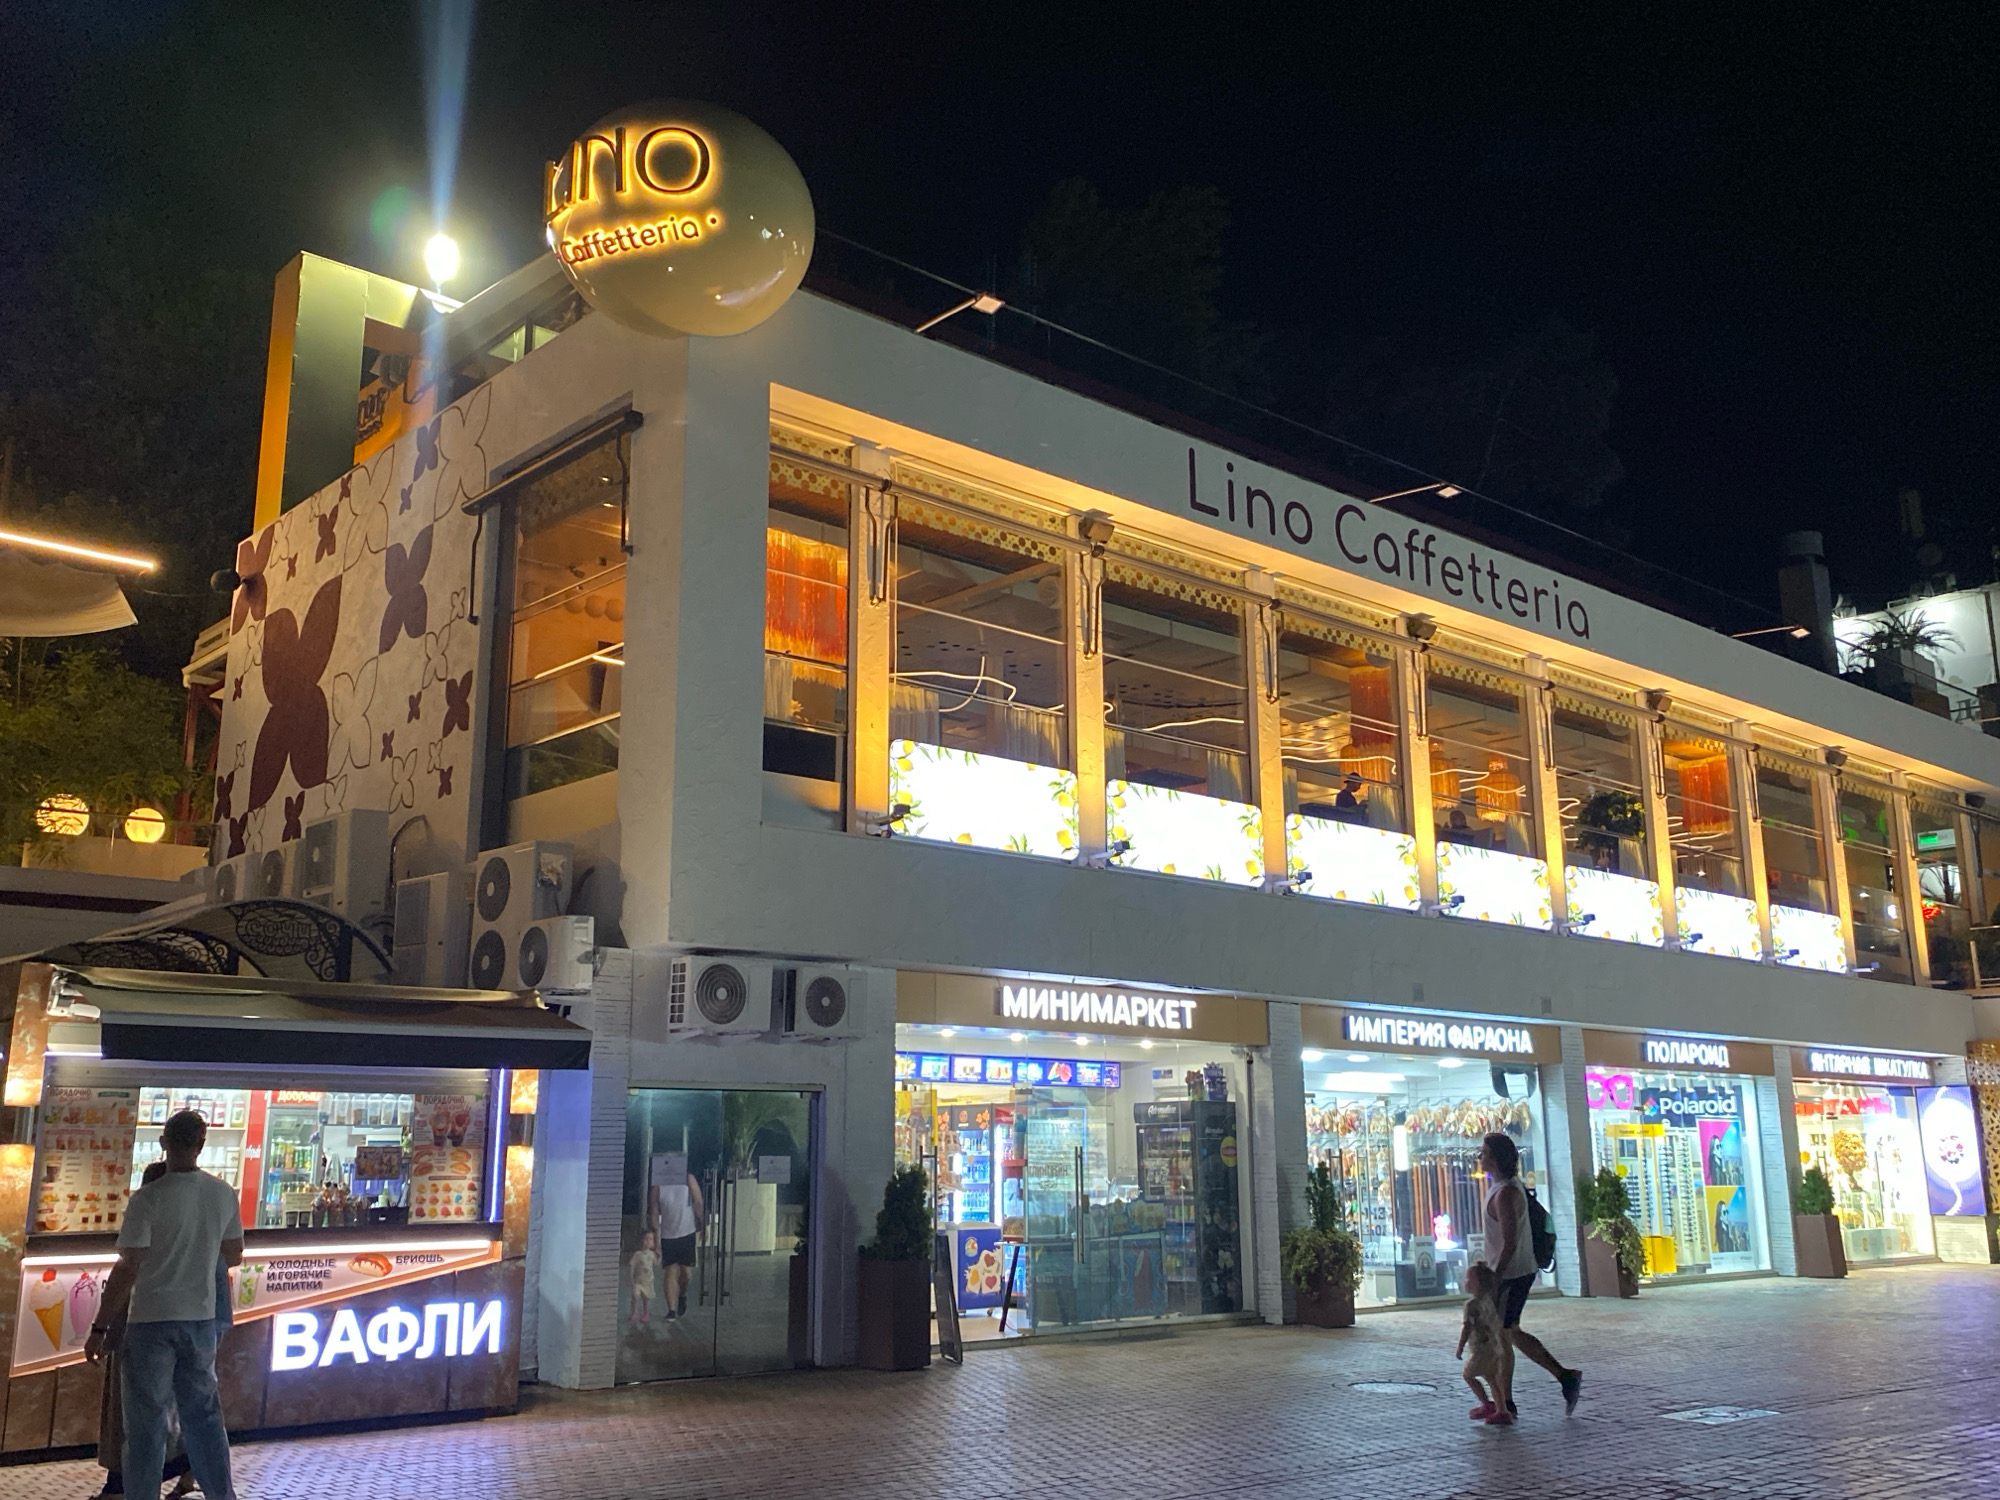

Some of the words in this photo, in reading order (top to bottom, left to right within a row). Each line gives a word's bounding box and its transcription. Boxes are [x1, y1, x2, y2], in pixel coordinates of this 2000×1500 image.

[560, 216, 699, 265] Caffetteria
[1188, 447, 1313, 545] Lino
[1335, 504, 1591, 640] Caffetteria
[1002, 985, 1197, 1030] МИНИМАРКЕТ
[1348, 1015, 1446, 1047] ИМПЕРИЯ
[1447, 1024, 1534, 1054] ФАРАОНА
[1646, 1040, 1731, 1069] ПОЛАРОИД
[1810, 1051, 1871, 1075] ЯНТАРНАЯ
[1873, 1057, 1931, 1080] ШКАТУЛКА
[1659, 1096, 1738, 1115] Polaroid
[268, 1257, 337, 1270] ХОЛОДНЫЕ
[395, 1254, 446, 1265] БРИОШЬ
[266, 1280, 323, 1292] НАПИТКИ
[277, 1269, 331, 1281] ГОРЯЧИЕ
[271, 1300, 502, 1371] ВАФЛИ
